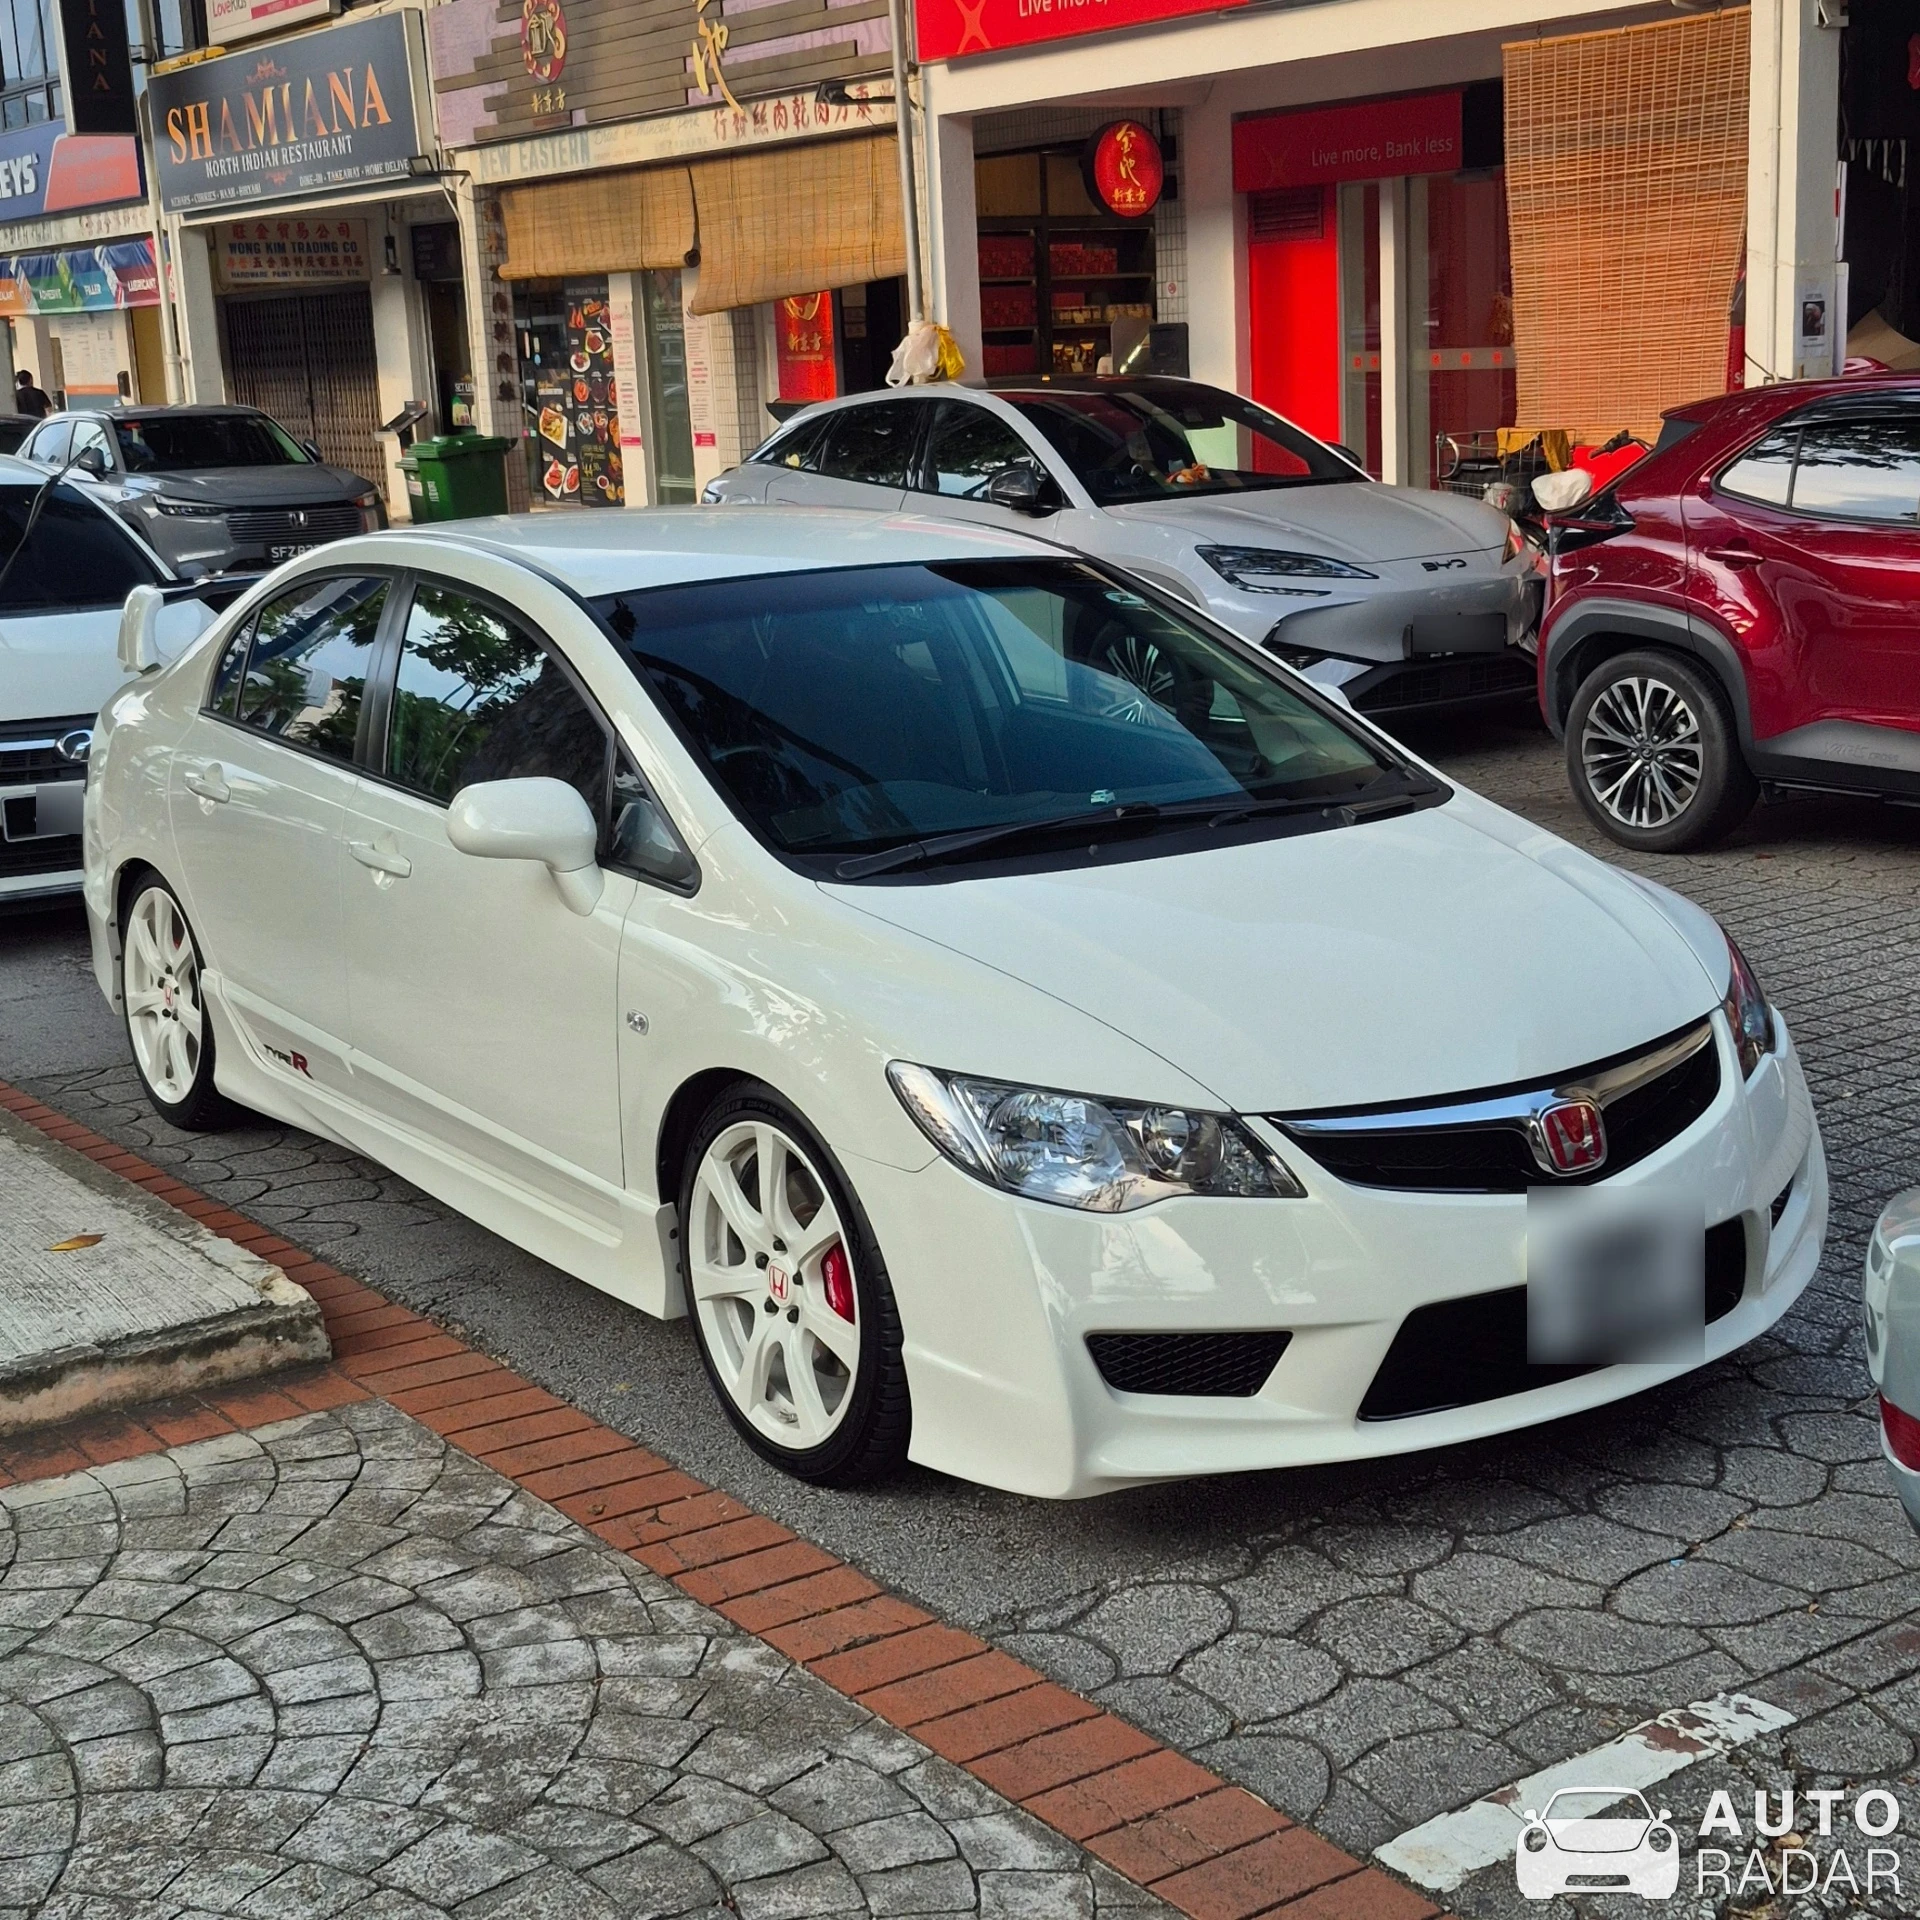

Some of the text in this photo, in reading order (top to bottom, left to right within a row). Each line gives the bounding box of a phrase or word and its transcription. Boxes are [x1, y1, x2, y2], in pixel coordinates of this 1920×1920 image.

[166, 63, 392, 166] SHAMIANA
[205, 134, 352, 178] NORTH INDIAN RESTAURANT
[479, 130, 591, 180] NEW EASTERN
[1312, 136, 1453, 167] Live more, Bank less
[326, 165, 361, 182] TAKEAWAY
[364, 161, 384, 177] HOME
[385, 158, 410, 173] DELIVE
[228, 241, 358, 255] WONG KIM TRADING CO
[1421, 558, 1467, 572] BYD
[289, 1050, 315, 1080] R
